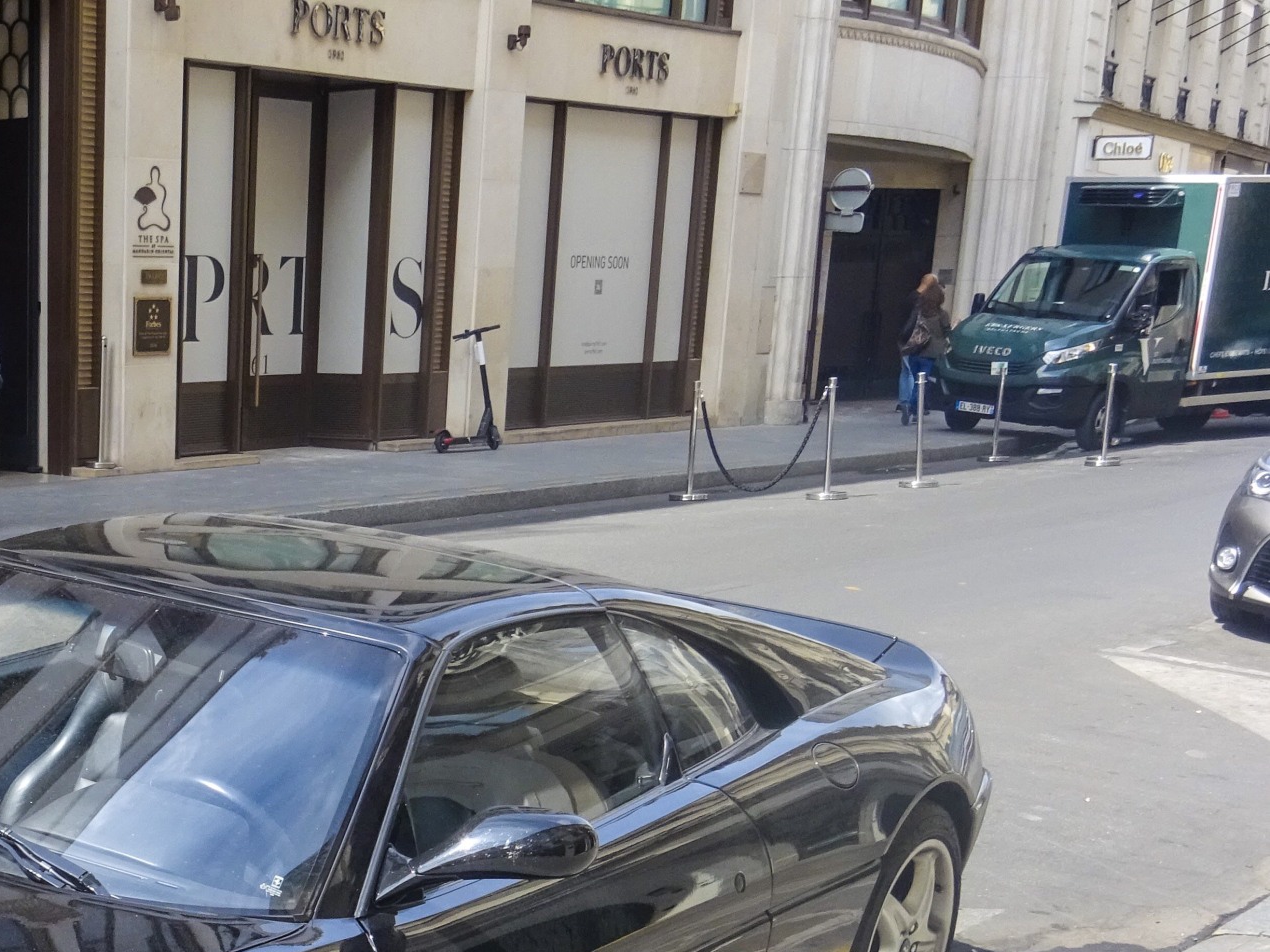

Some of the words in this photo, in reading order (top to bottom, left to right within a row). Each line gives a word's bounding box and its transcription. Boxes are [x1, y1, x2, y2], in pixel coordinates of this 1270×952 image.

[291, 0, 386, 44] PORTS
[600, 43, 670, 81] PORTS
[1103, 141, 1143, 155] Chloé
[138, 234, 153, 243] THE
[155, 235, 169, 243] SPA
[570, 255, 606, 269] OPENING
[607, 255, 630, 269] SOON
[973, 345, 1012, 356] IVECO
